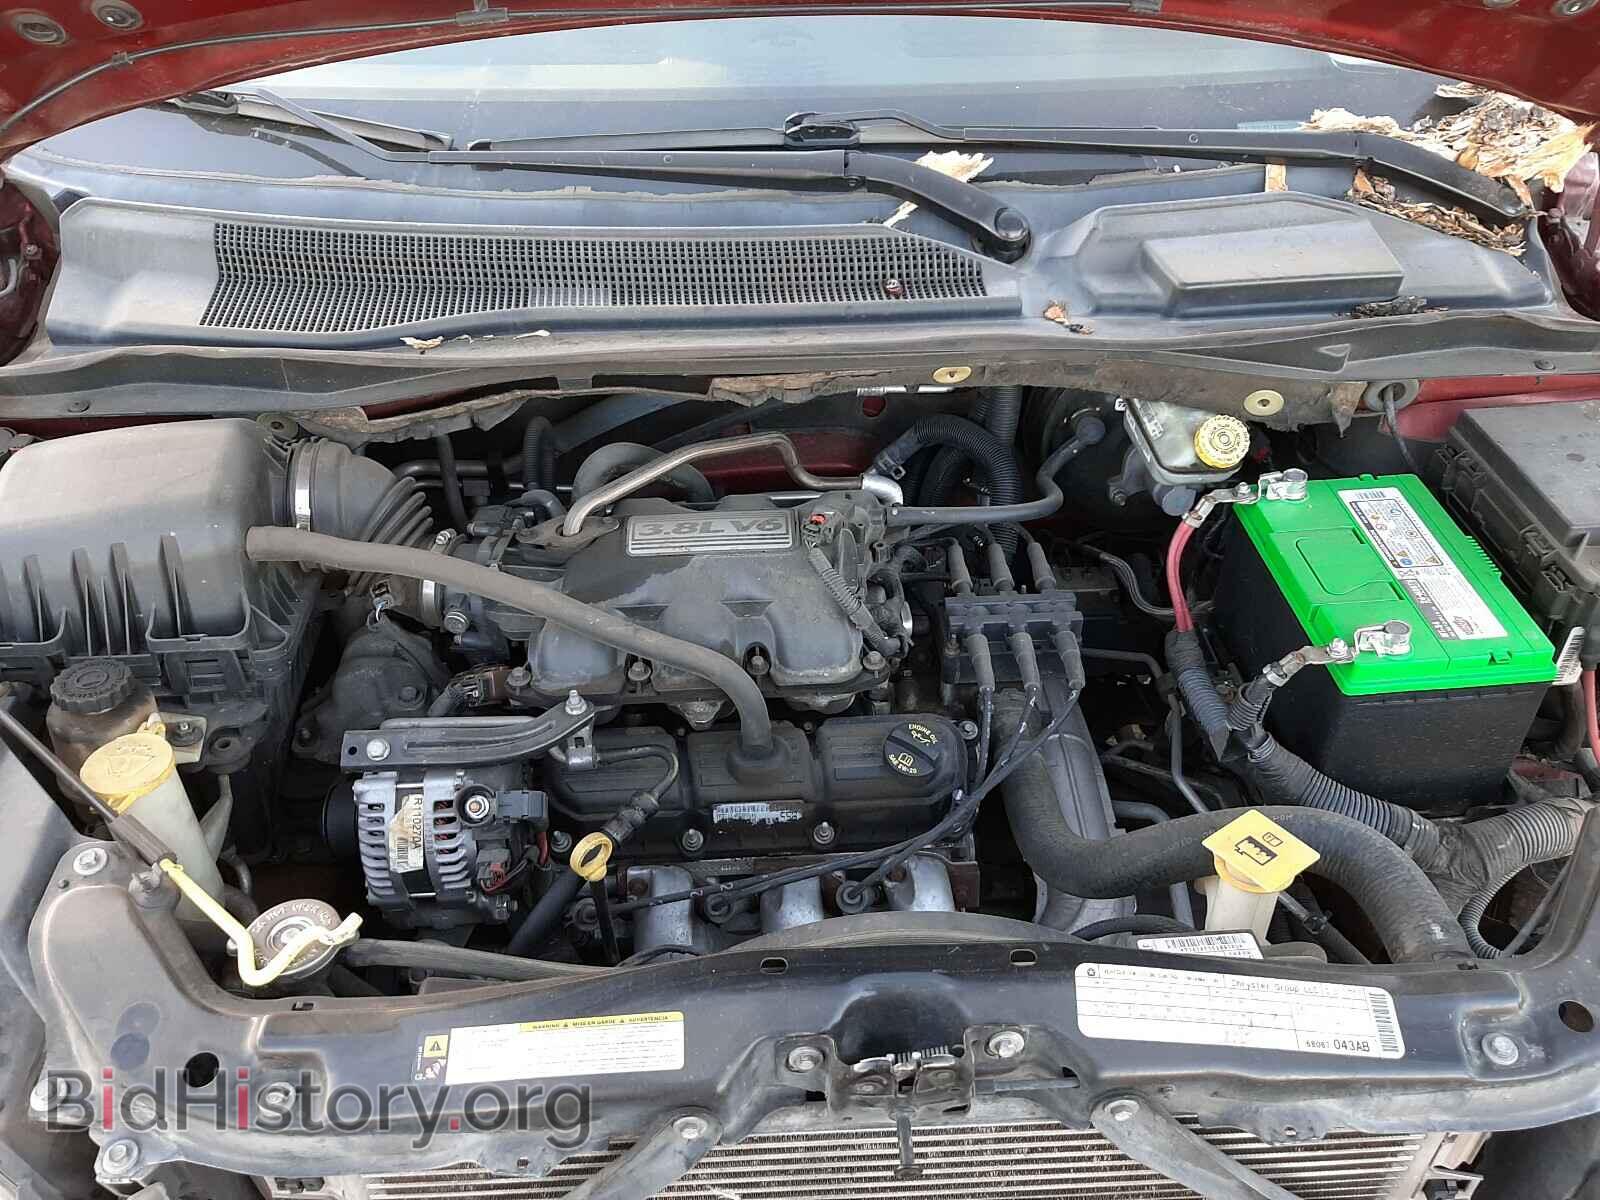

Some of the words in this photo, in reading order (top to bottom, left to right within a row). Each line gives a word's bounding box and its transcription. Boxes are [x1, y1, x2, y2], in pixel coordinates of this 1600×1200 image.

[638, 521, 725, 536] 3.8L
[729, 518, 783, 532] V6
[909, 723, 931, 736] ENGINE
[1333, 1039, 1370, 1052] 043AB
